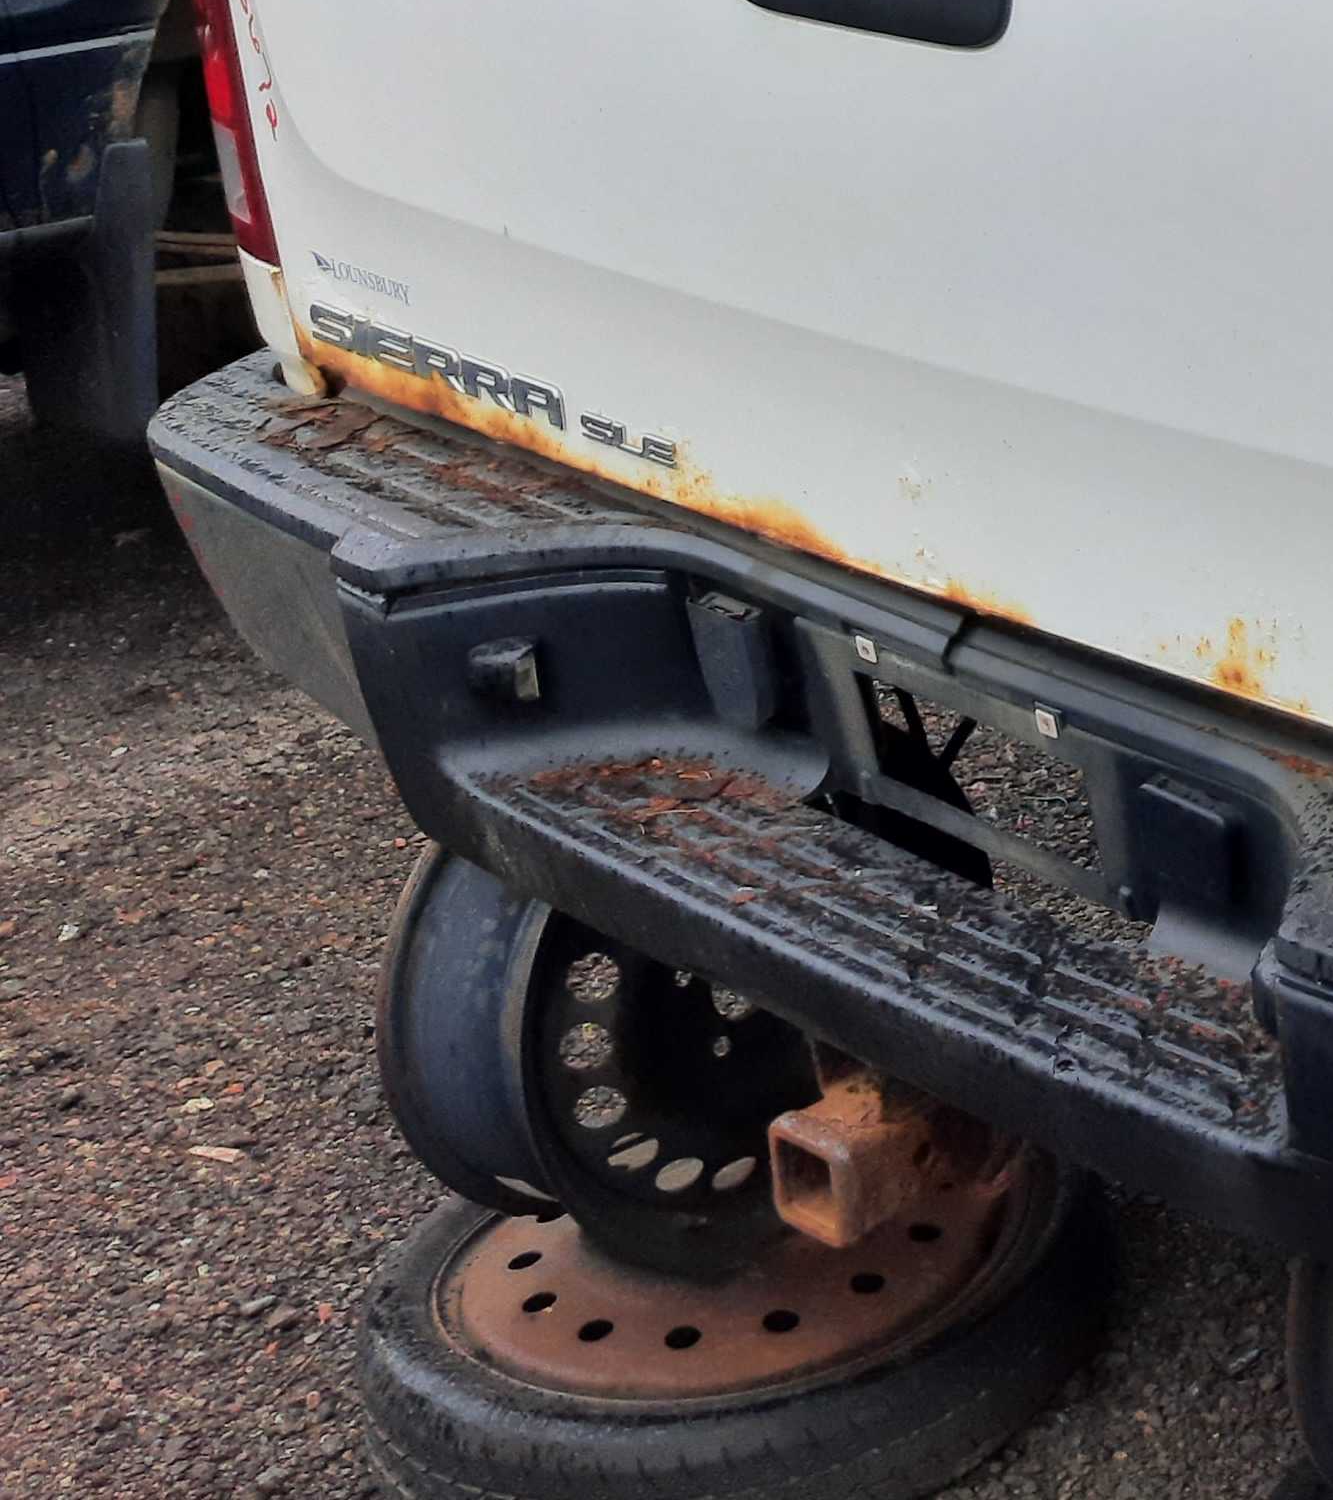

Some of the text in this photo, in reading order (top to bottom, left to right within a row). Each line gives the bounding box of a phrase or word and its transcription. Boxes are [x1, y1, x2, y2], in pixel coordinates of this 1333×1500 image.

[330, 257, 410, 306] LOUNSBURY
[309, 300, 678, 469] SIERRA SLE
